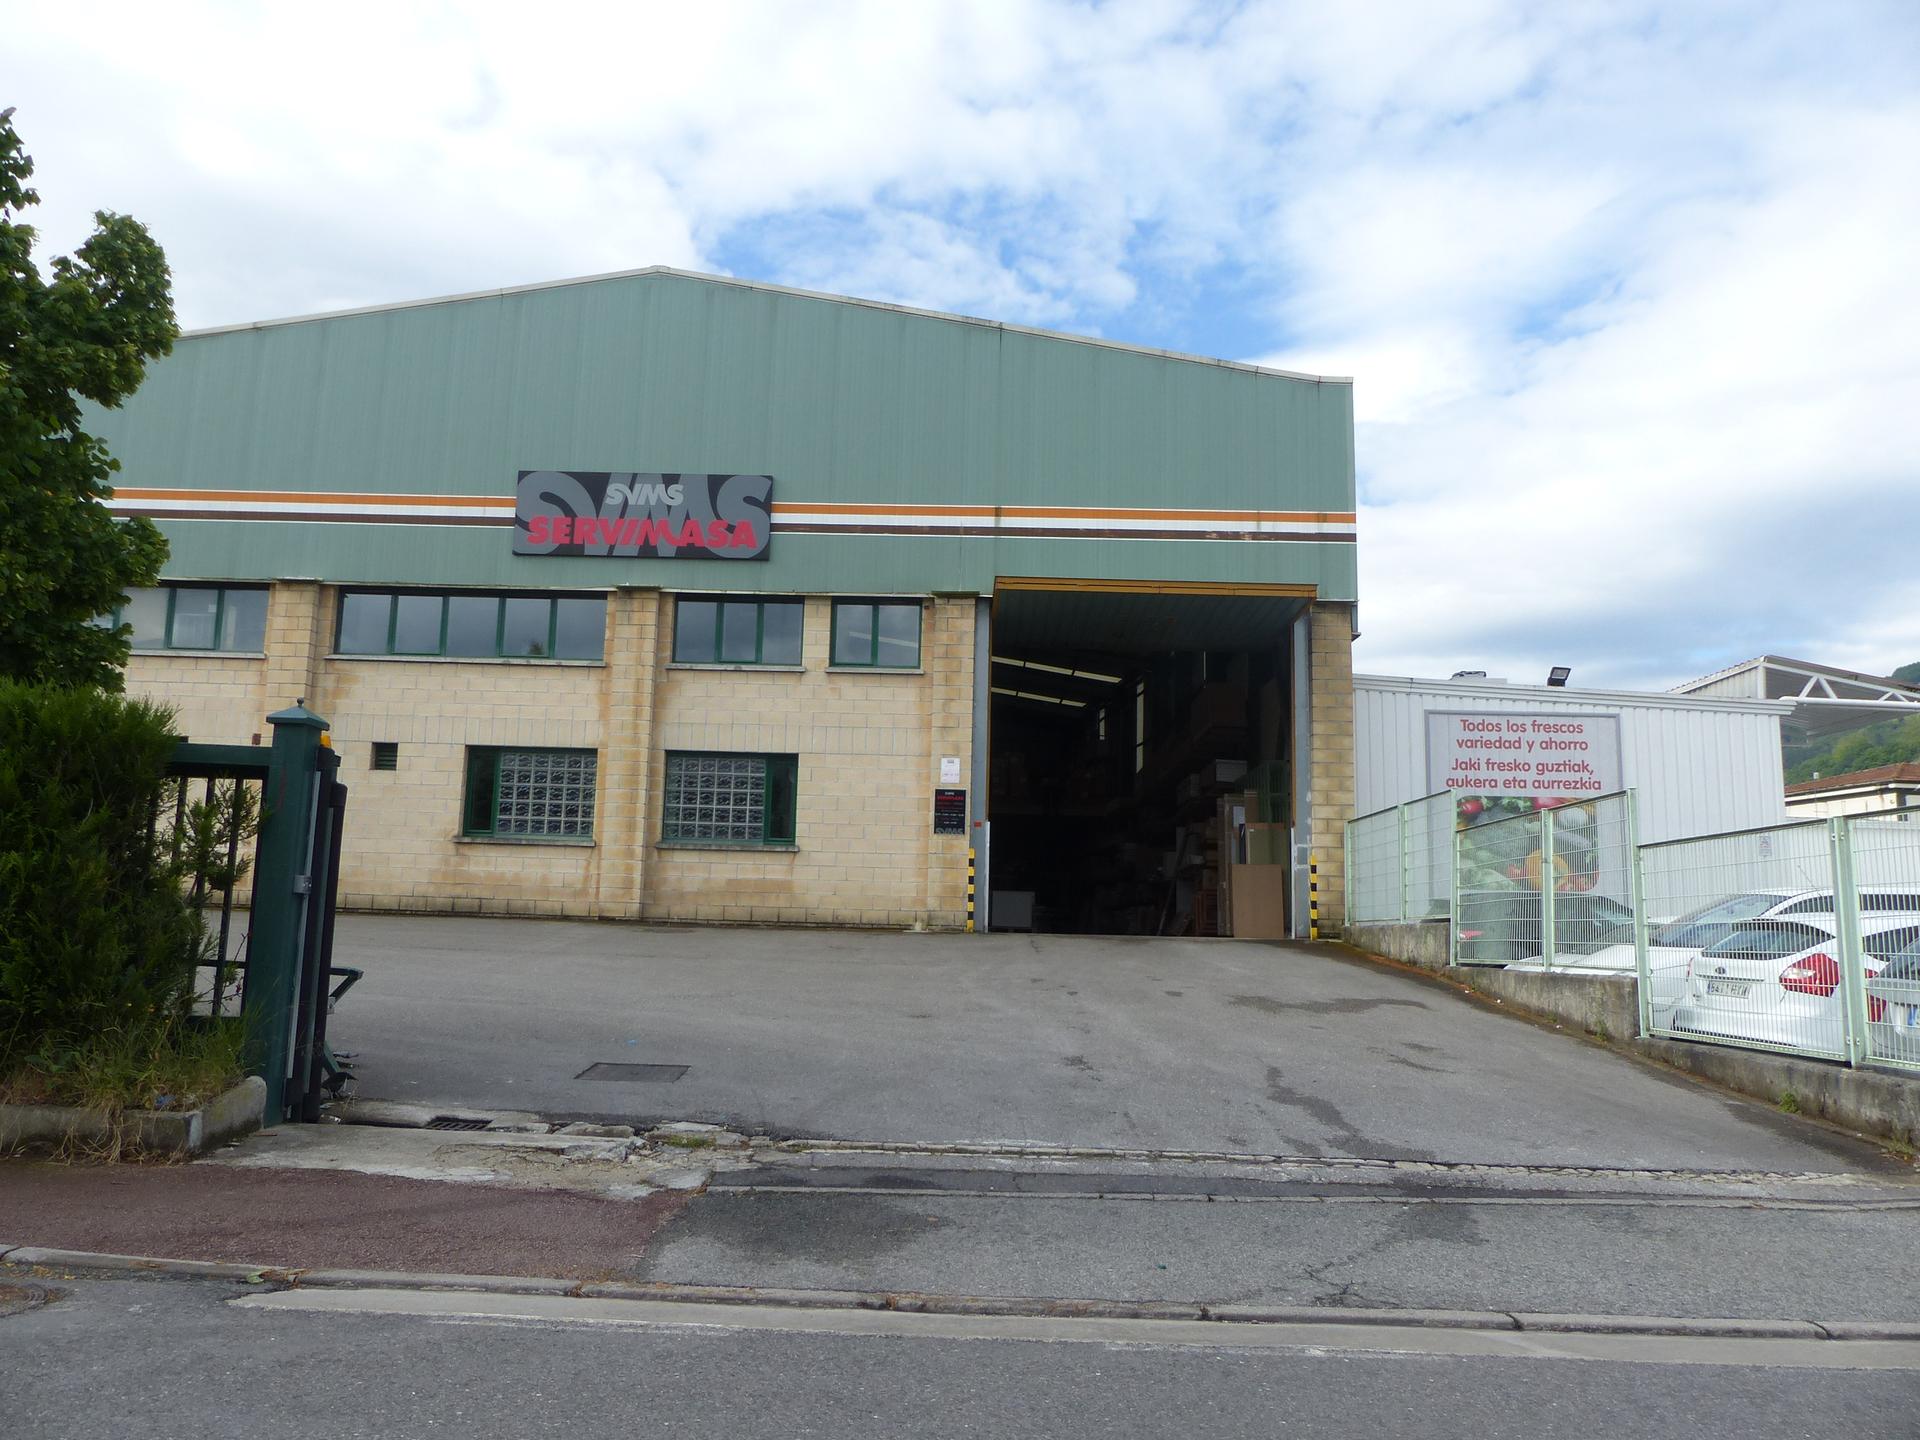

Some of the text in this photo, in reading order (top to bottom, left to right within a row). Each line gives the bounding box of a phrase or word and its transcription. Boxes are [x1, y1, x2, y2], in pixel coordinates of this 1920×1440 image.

[527, 516, 757, 548] SERVIMASA
[1460, 719, 1583, 733] Todos los frescos
[1456, 736, 1588, 753] variedad y ahorro
[1451, 758, 1594, 775] Jaki fresko guztiak,
[1446, 776, 1601, 790] aukera eta aurrezkia
